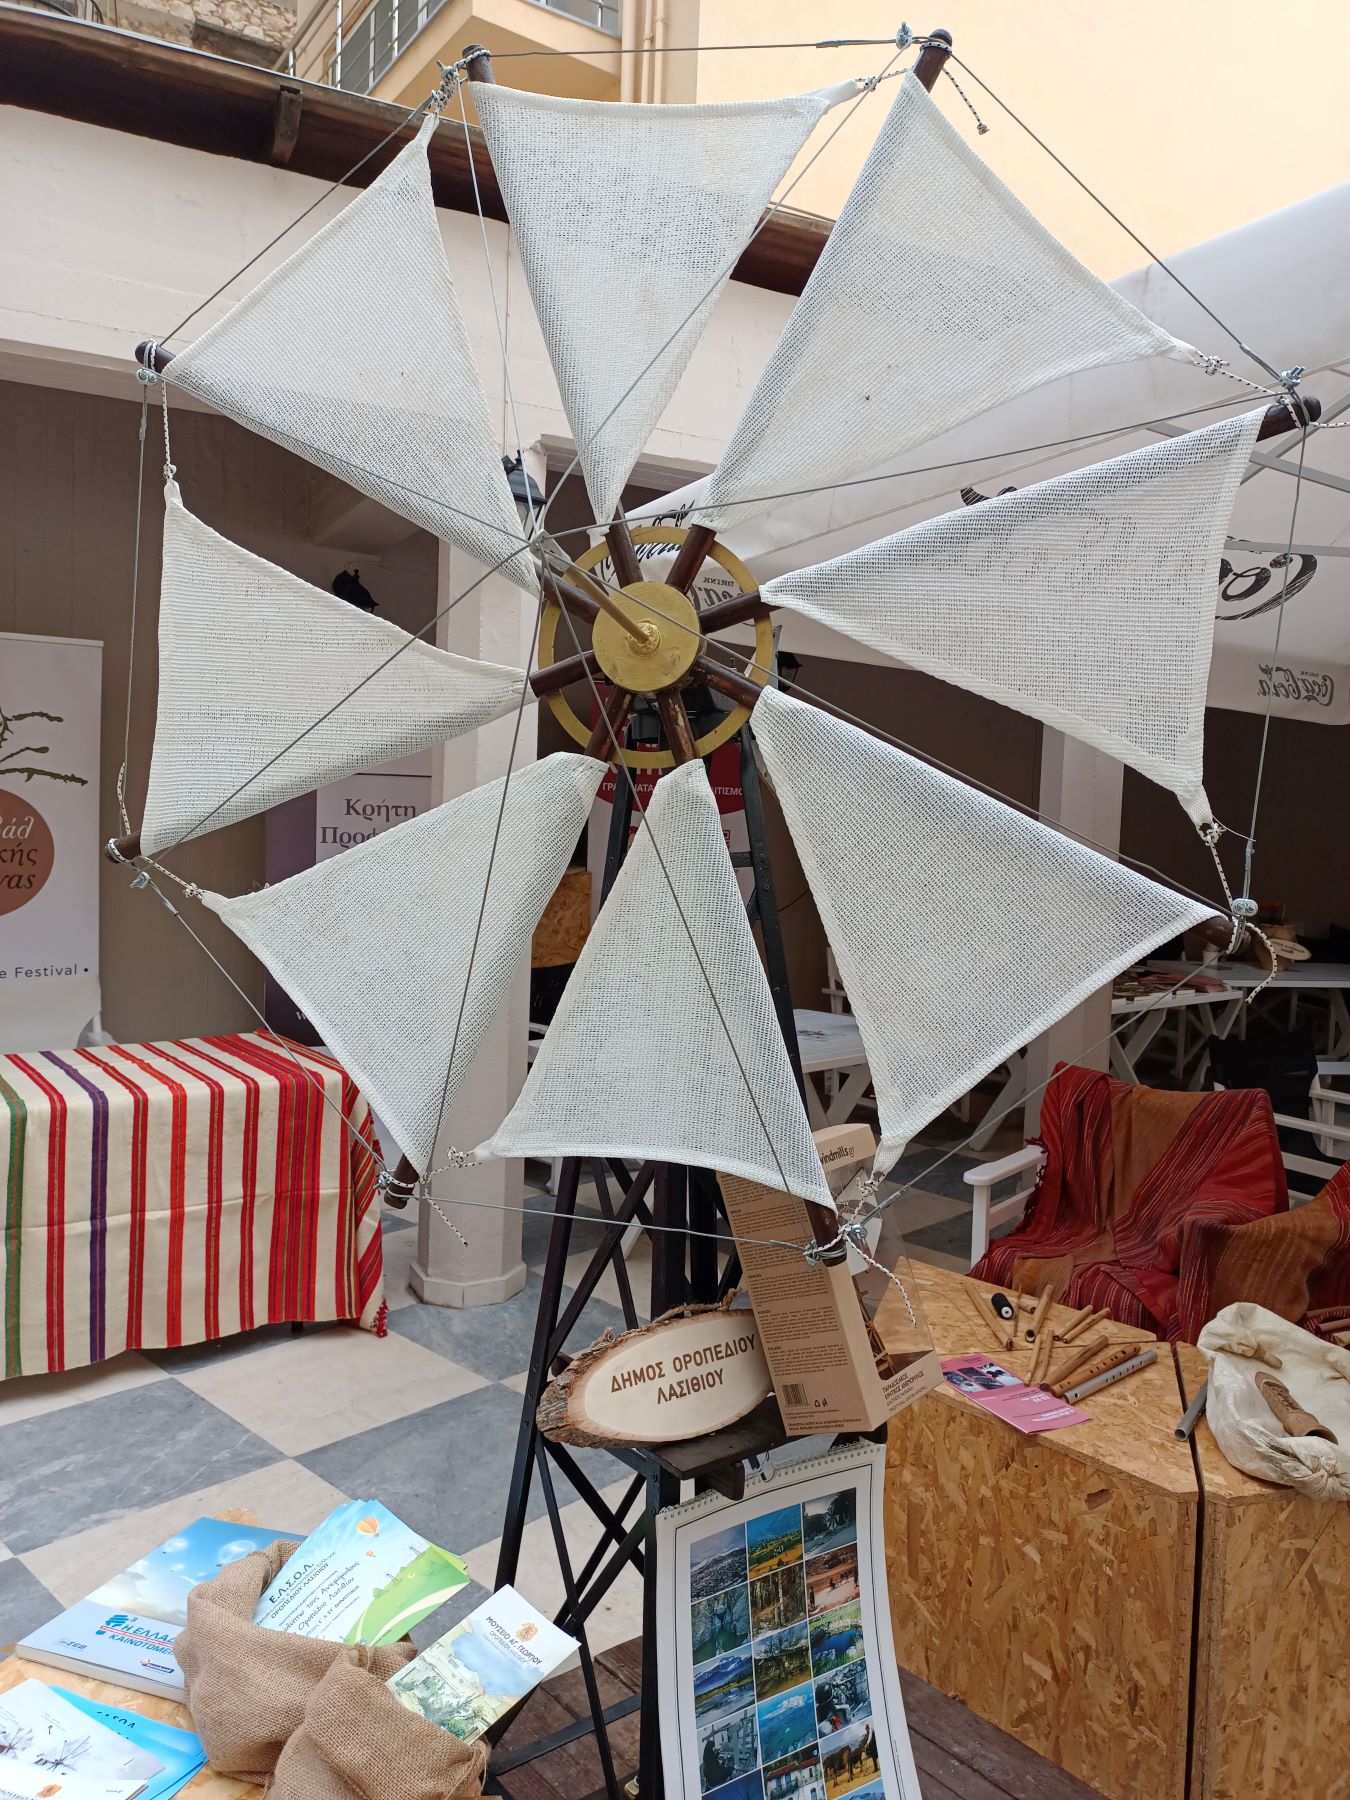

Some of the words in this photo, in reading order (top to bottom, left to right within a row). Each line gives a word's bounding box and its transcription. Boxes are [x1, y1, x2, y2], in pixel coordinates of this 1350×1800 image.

[602, 782, 654, 792] ΓΡΑΑΤΑ
[344, 798, 416, 823] Κρήτη
[15, 963, 77, 979] Festival
[611, 1361, 666, 1393] ΔΗΜΟΣ
[672, 1334, 755, 1373] ΟΡΟΠΕΔΙΟΥ
[657, 1368, 724, 1405] ΛΑΣΙΘΙΟΥ
[270, 1585, 303, 1619] ΟΡΟΠΕΔΙΟΥ
[108, 1634, 174, 1655] ΚΑΙΝΟΤΟΜΕΙ
[486, 1616, 511, 1640] ΜΟΥΣΕΙΟ
[517, 1645, 543, 1665] ΓΕΩΡΓΙΟΥ
